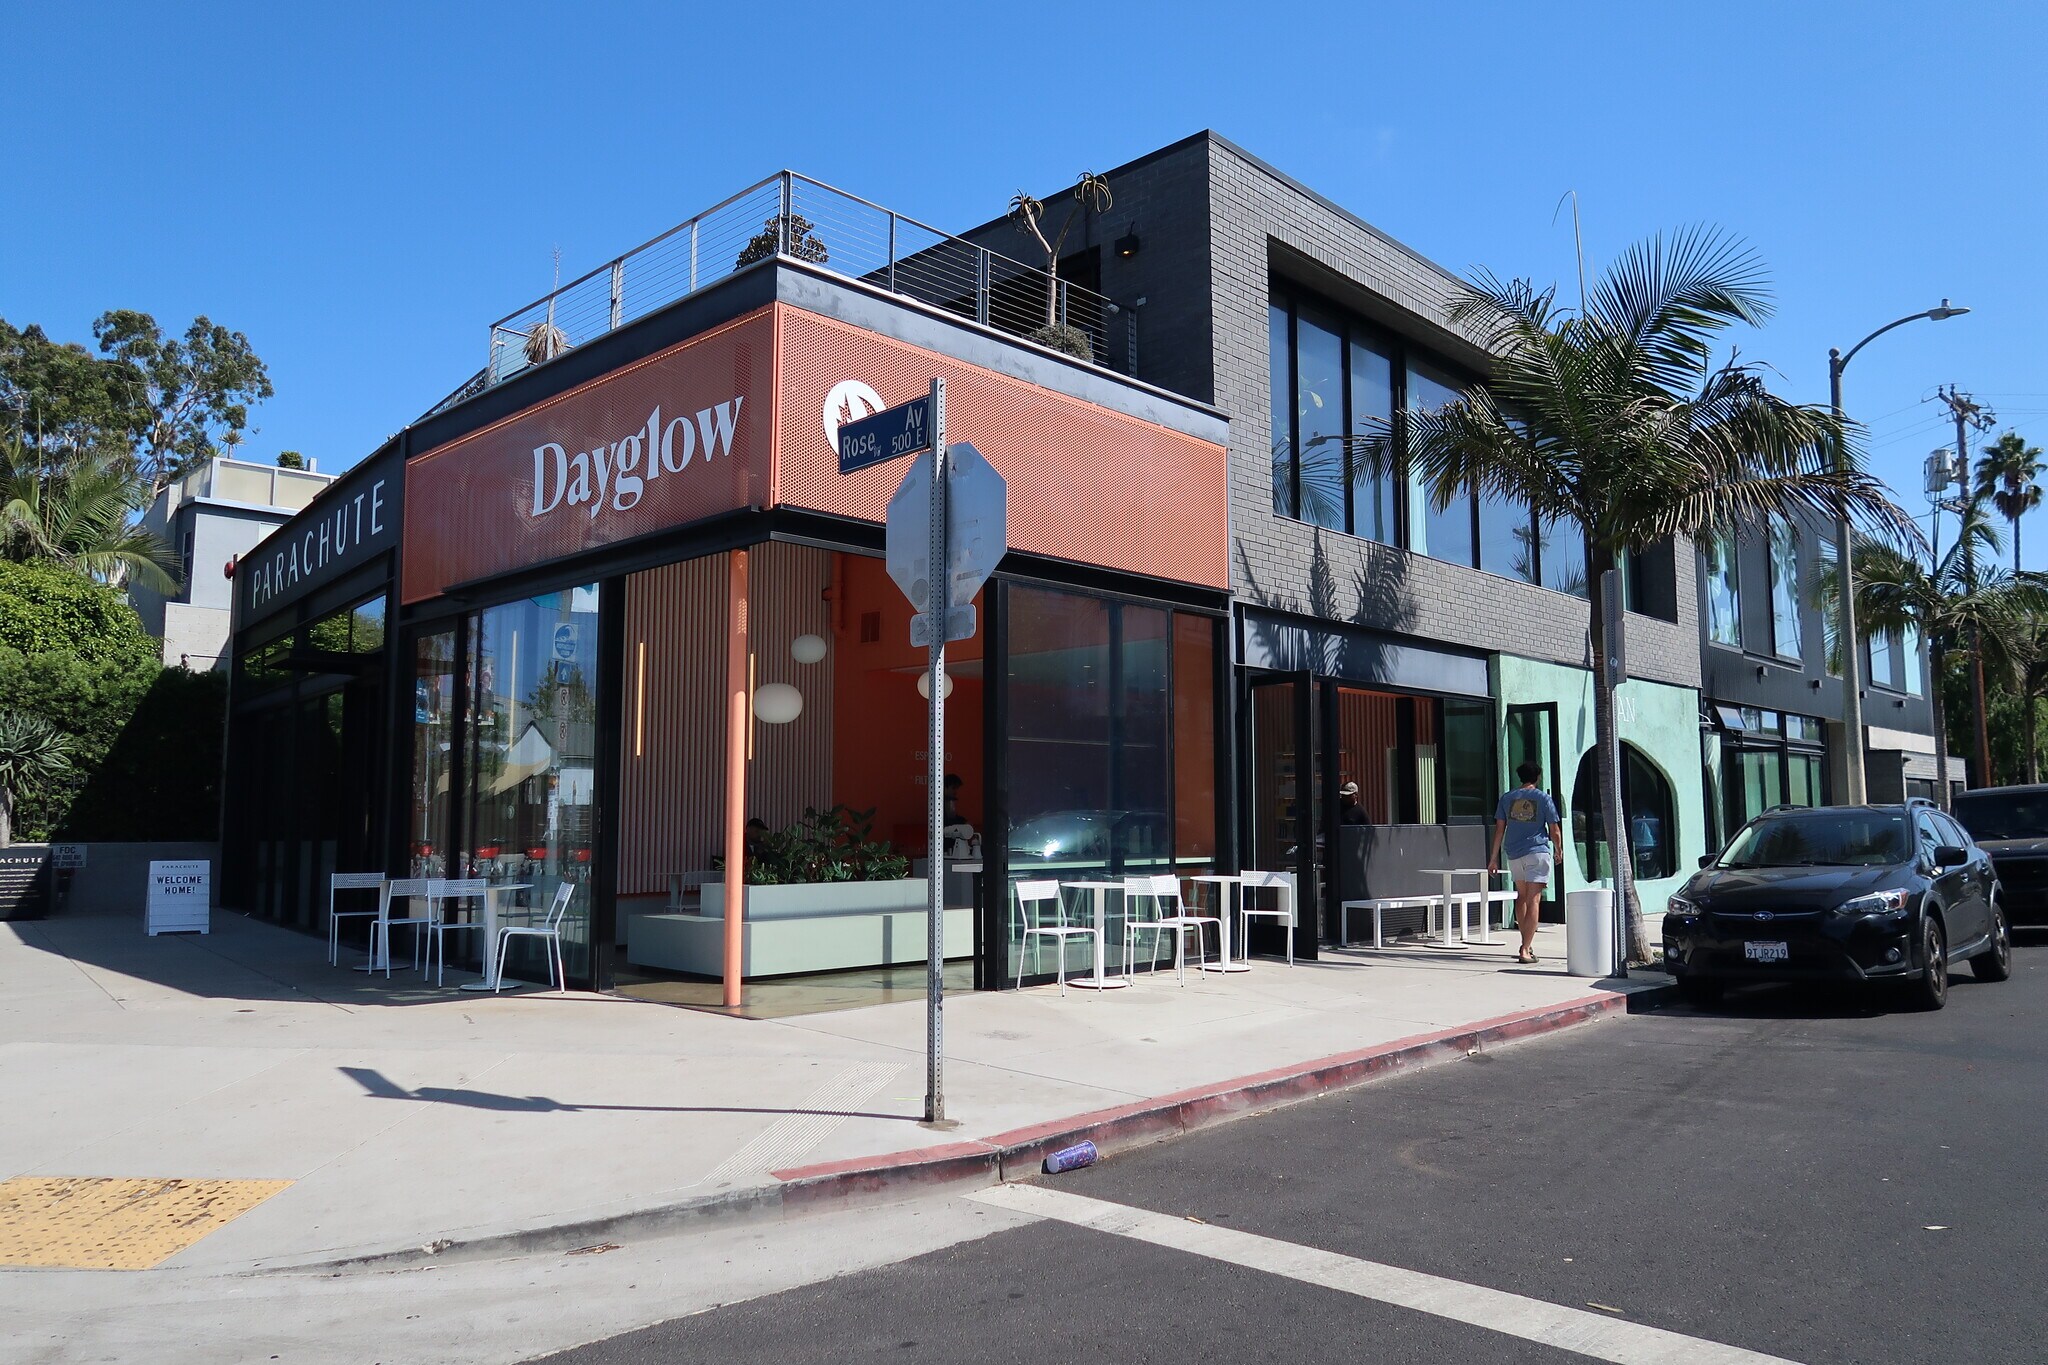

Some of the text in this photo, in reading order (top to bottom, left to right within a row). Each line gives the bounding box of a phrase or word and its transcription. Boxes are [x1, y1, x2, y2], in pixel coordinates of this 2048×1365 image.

[843, 432, 875, 460] Rose
[905, 405, 923, 431] Av
[892, 433, 911, 453] 500
[916, 428, 923, 445] E
[532, 395, 744, 519] Dayglow
[252, 479, 385, 609] PARACHUTE
[156, 876, 202, 884] WELCOME
[164, 886, 196, 895] HOME!
